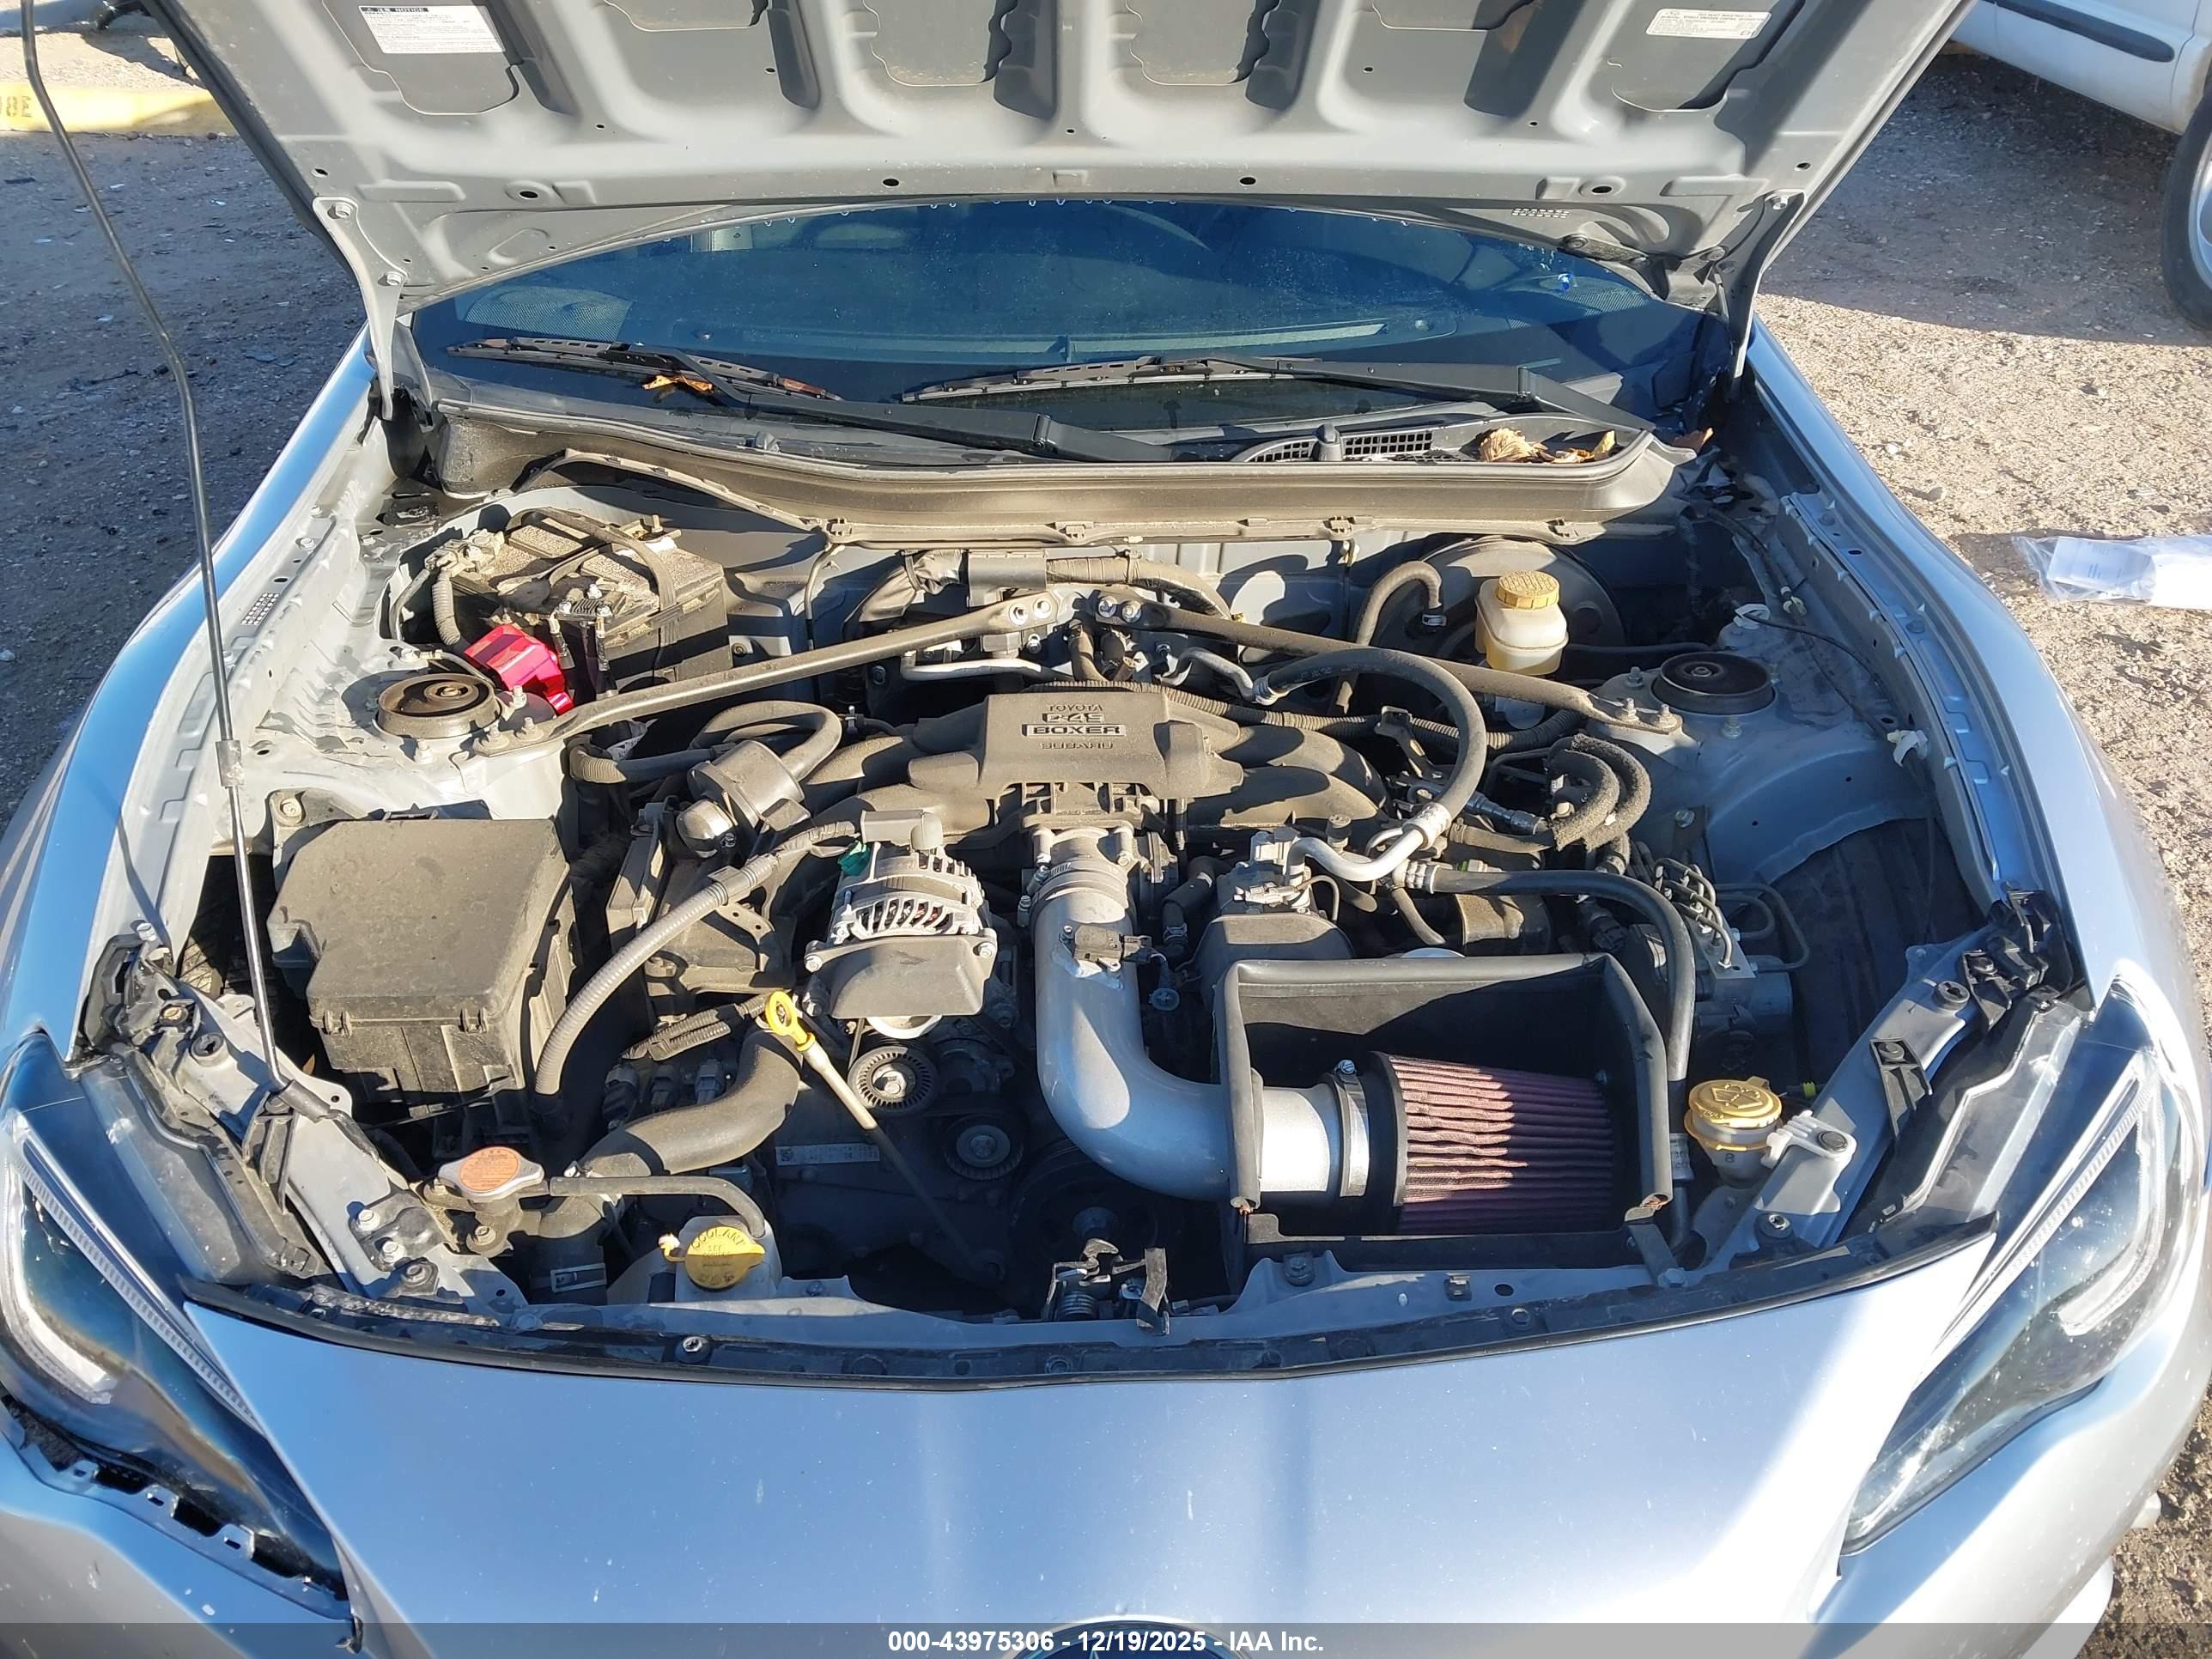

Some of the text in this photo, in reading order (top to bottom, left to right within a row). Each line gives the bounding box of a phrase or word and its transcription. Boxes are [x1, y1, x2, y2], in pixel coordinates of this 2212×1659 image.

[1048, 703, 1103, 712] TOYOTA
[1033, 726, 1121, 734] BOXER
[1040, 741, 1115, 750] SUBARU
[691, 1227, 746, 1249] COOLANT
